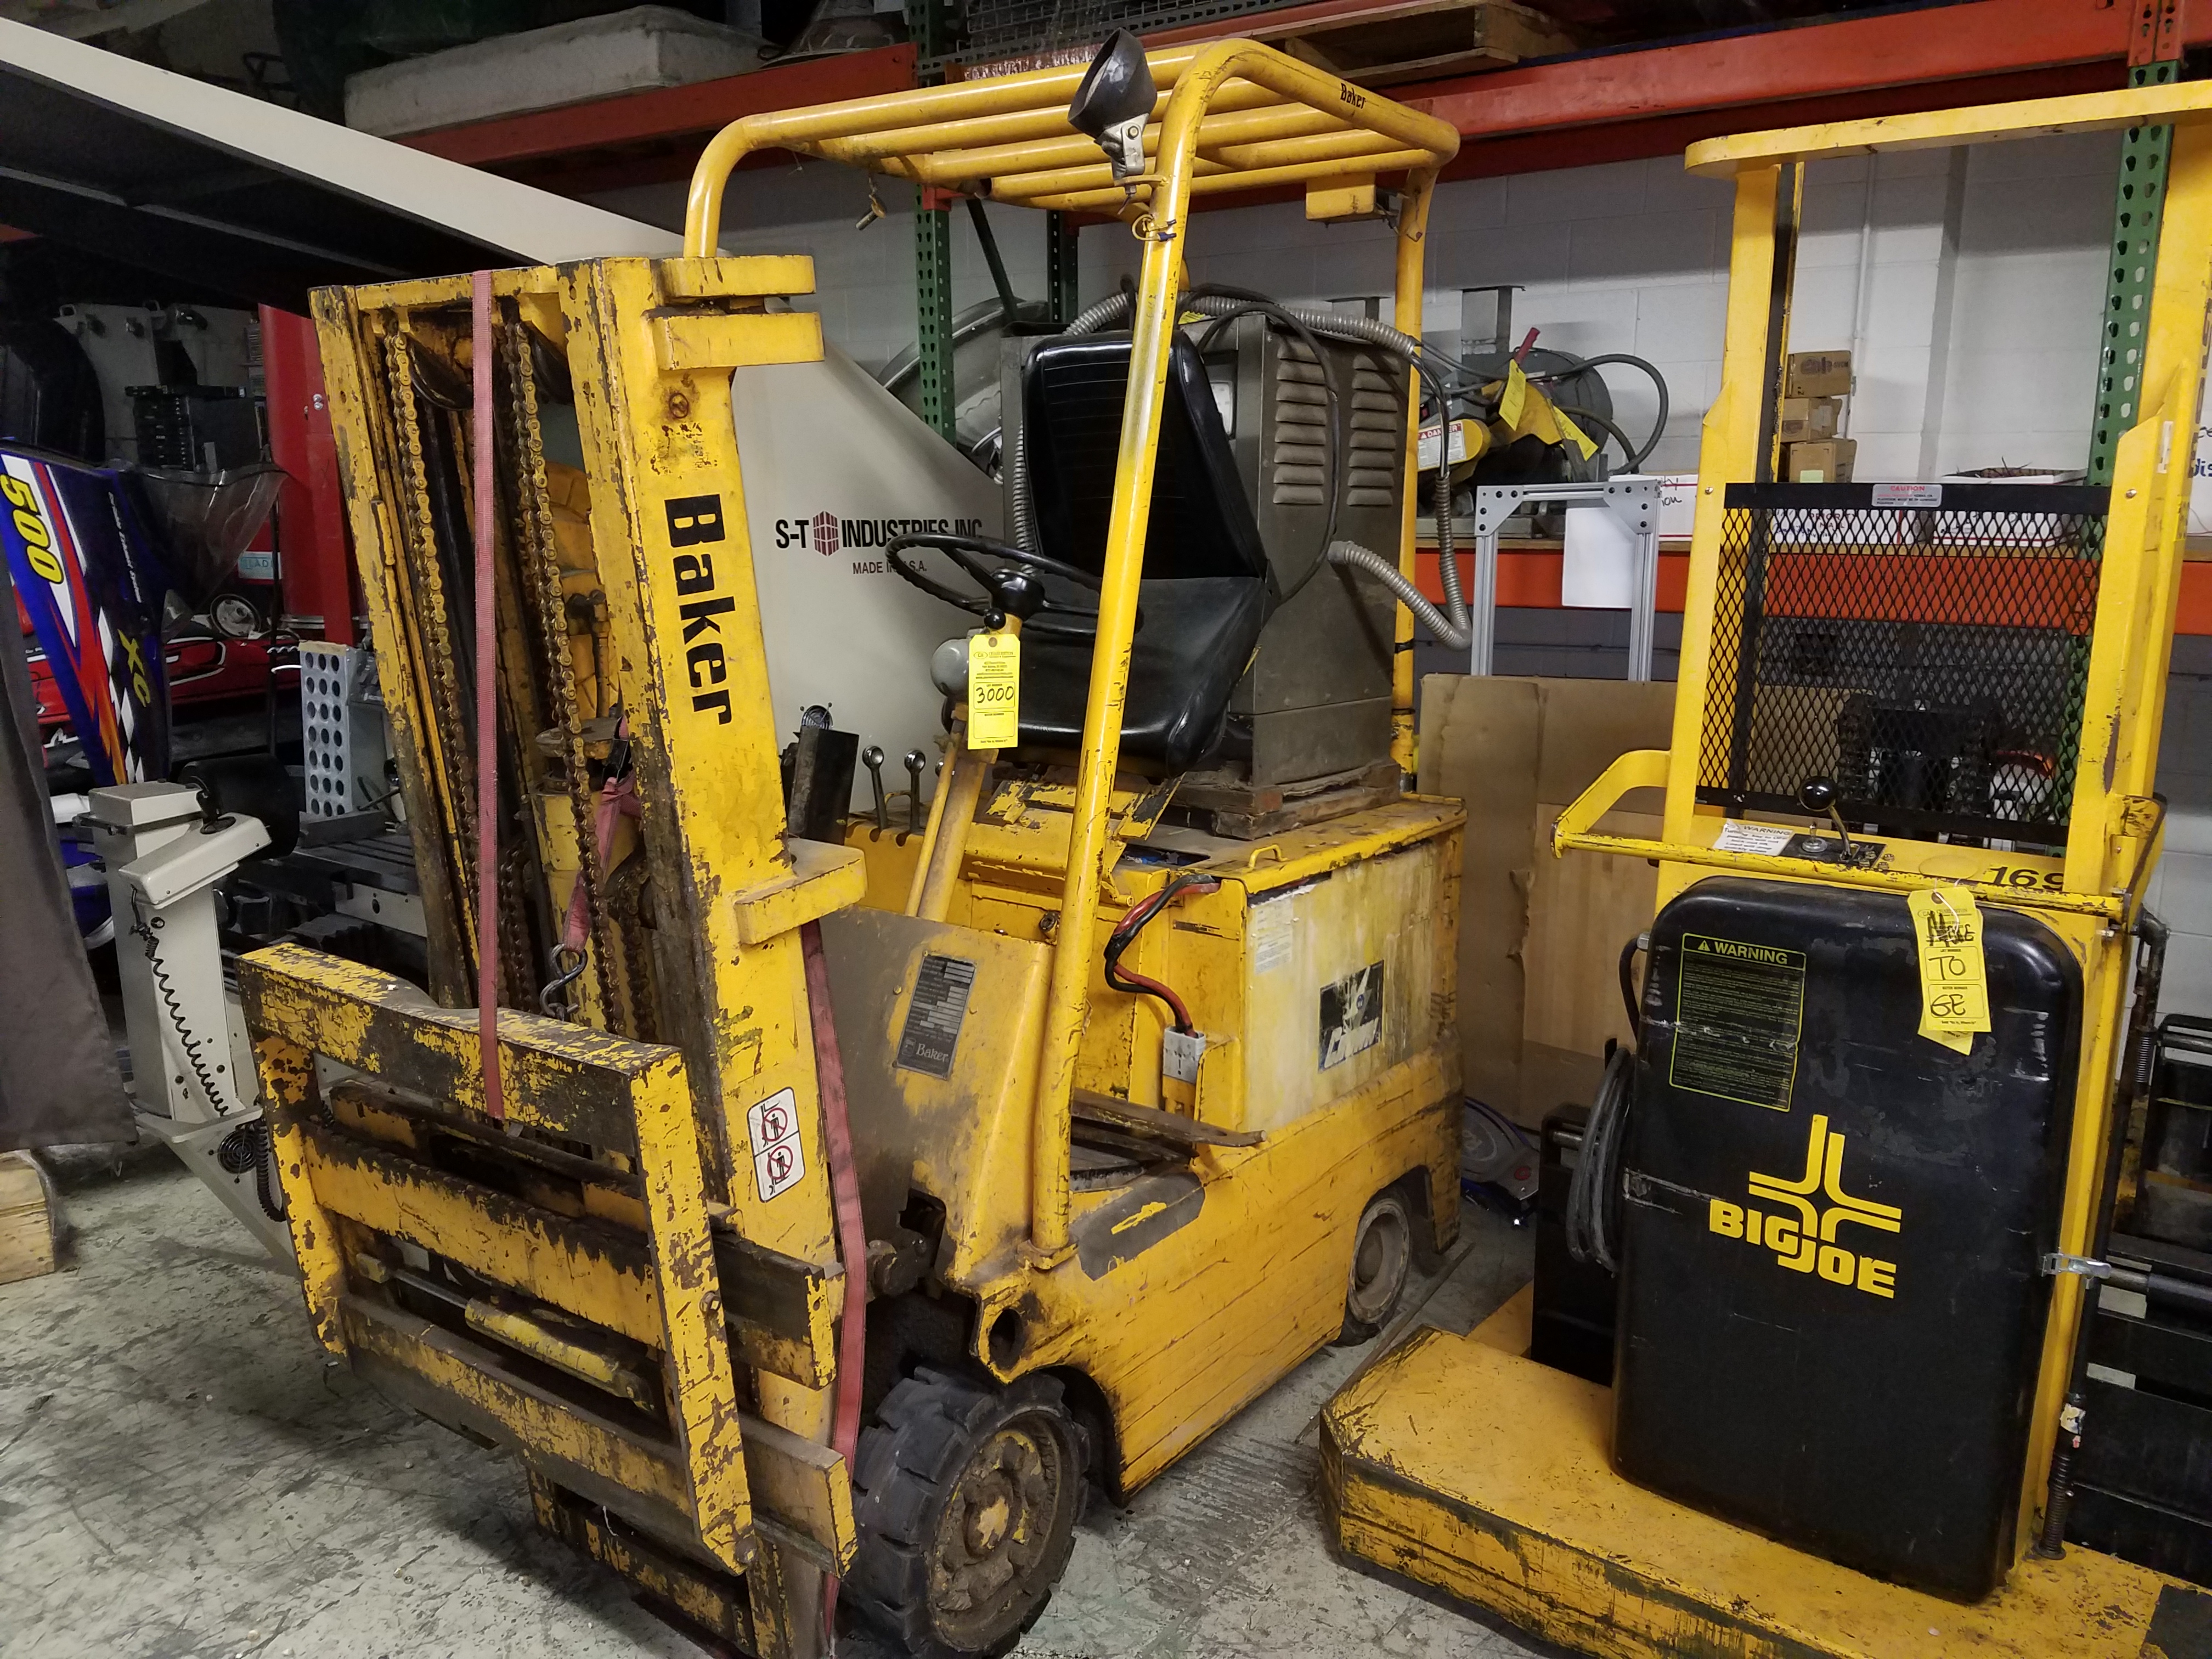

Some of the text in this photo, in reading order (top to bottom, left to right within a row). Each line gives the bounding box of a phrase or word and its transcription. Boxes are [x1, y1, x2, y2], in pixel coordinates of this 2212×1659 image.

[1340, 83, 1367, 109] Baker
[1427, 425, 1458, 438] DANER
[0, 473, 64, 585] 500
[775, 519, 810, 549] S-T
[853, 561, 883, 574] MADE
[664, 494, 736, 725] Baker
[117, 628, 151, 708] XC
[975, 686, 1014, 704] 3000
[1743, 826, 1792, 836] WARNING
[1714, 941, 1788, 966] WARNING
[1928, 956, 1966, 980] TO
[916, 1043, 949, 1062] Baker
[1709, 1198, 1897, 1299] BIG JOE
